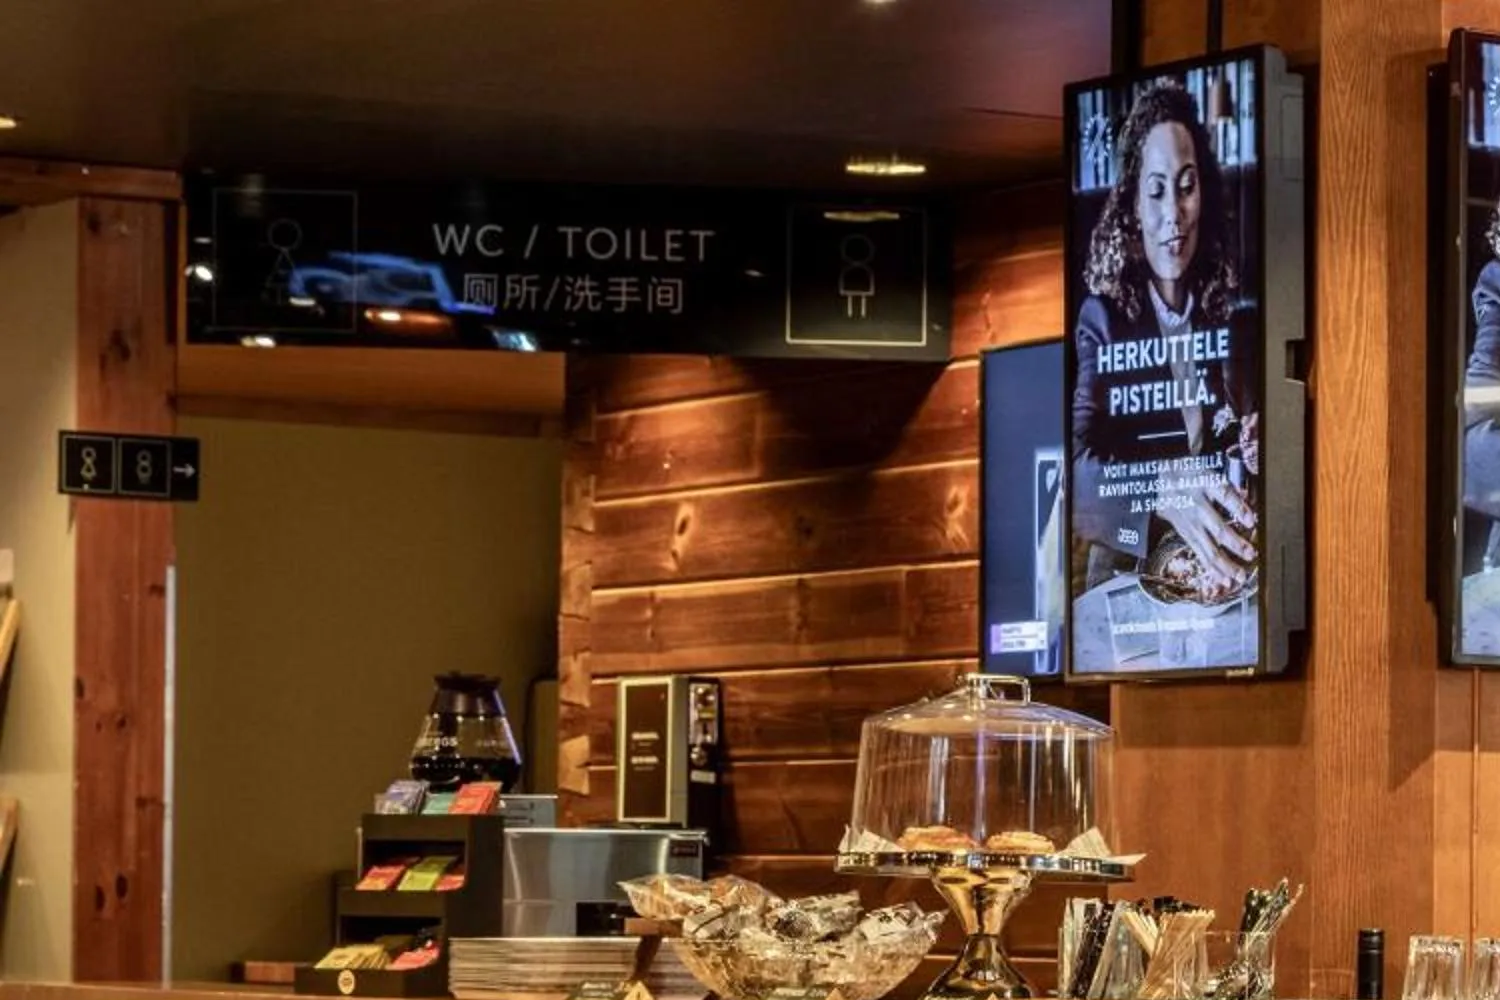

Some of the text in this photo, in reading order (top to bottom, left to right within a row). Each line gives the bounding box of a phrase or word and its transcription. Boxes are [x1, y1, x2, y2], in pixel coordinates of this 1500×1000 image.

[432, 223, 716, 261] WC / TOILET
[463, 273, 683, 314] 厕所/洗手间
[1097, 328, 1229, 374] HERKUTTELE
[1109, 367, 1216, 417] PISTEILLÄ.
[1103, 463, 1127, 478] VOIT
